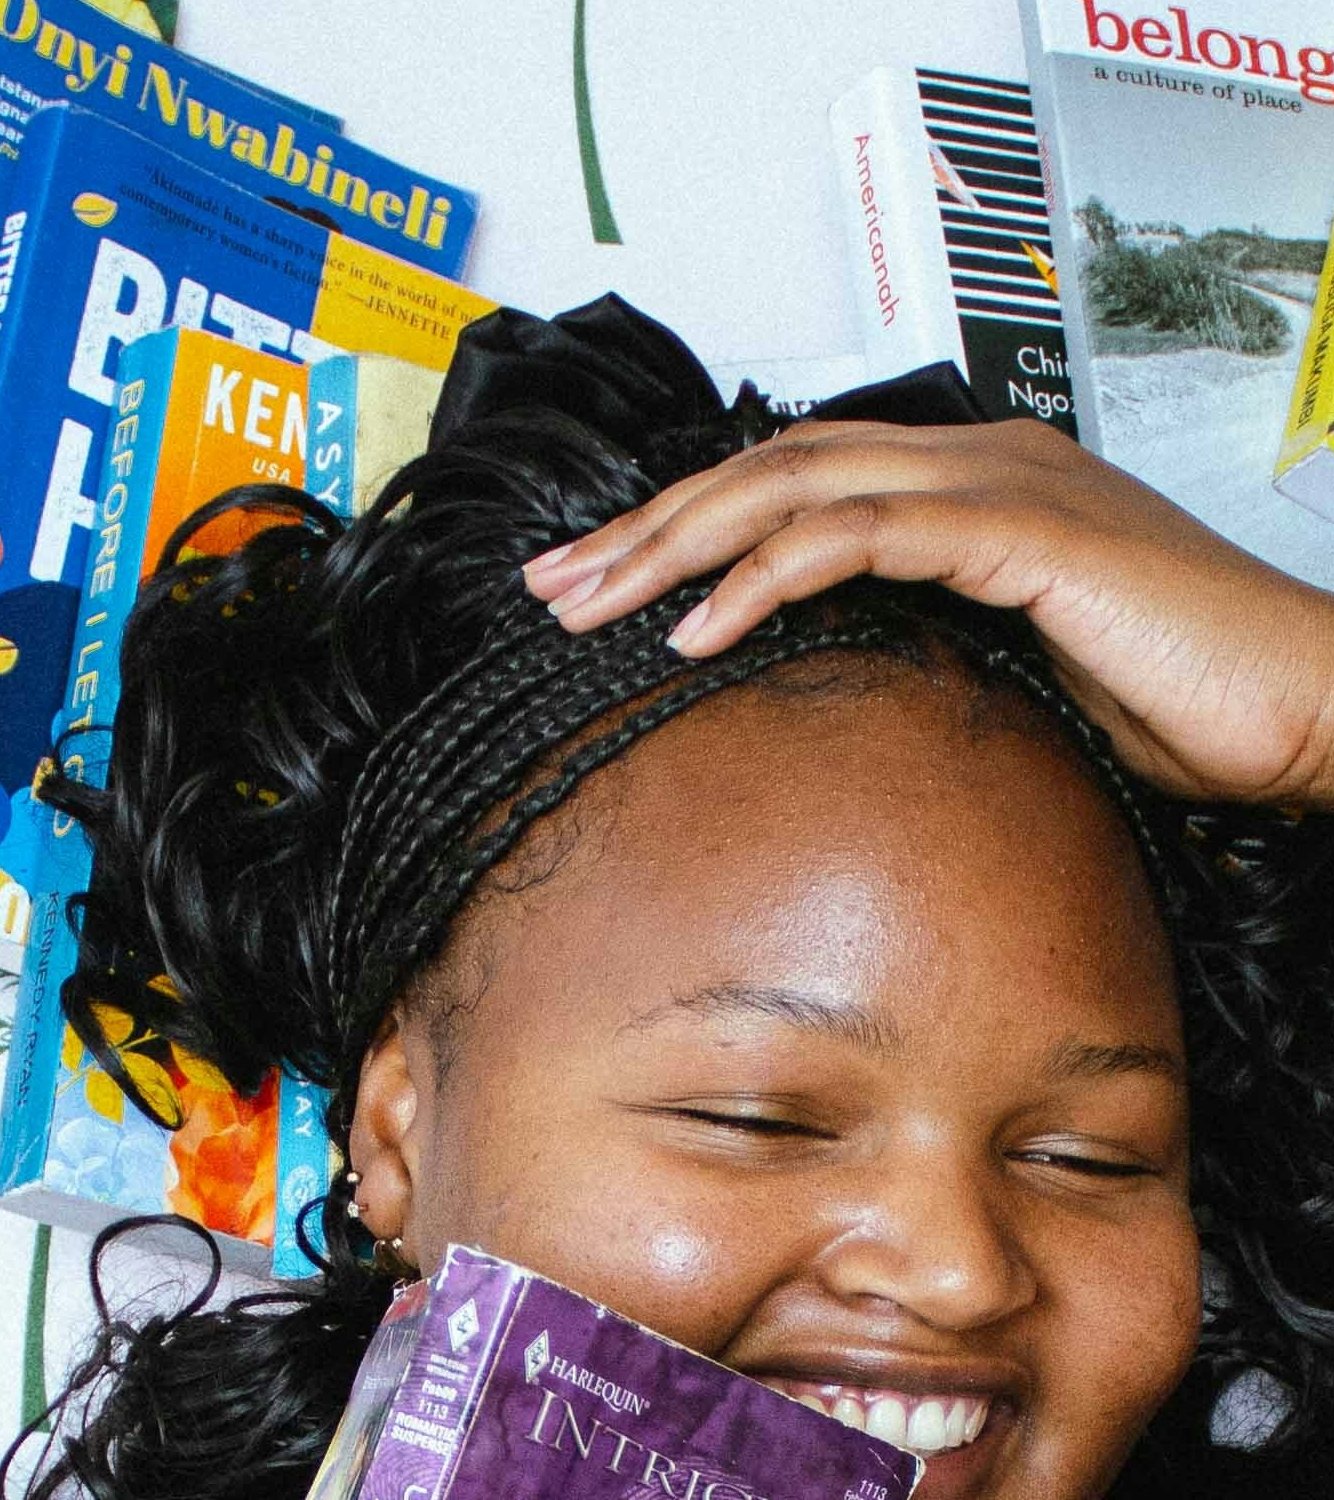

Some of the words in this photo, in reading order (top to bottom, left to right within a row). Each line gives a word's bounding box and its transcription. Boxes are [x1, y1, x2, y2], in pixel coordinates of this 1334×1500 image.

[137, 60, 453, 250] Nwabineli
[1093, 64, 1109, 81] a
[1115, 68, 1205, 96] culture
[1211, 82, 1238, 101] of
[1242, 86, 1305, 115] place
[852, 132, 901, 328] Americanah
[89, 378, 146, 599] BEFORE
[30, 890, 60, 1024] KENNEDY
[17, 1030, 40, 1108] RYAN
[548, 1354, 646, 1417] HARLEQUIN
